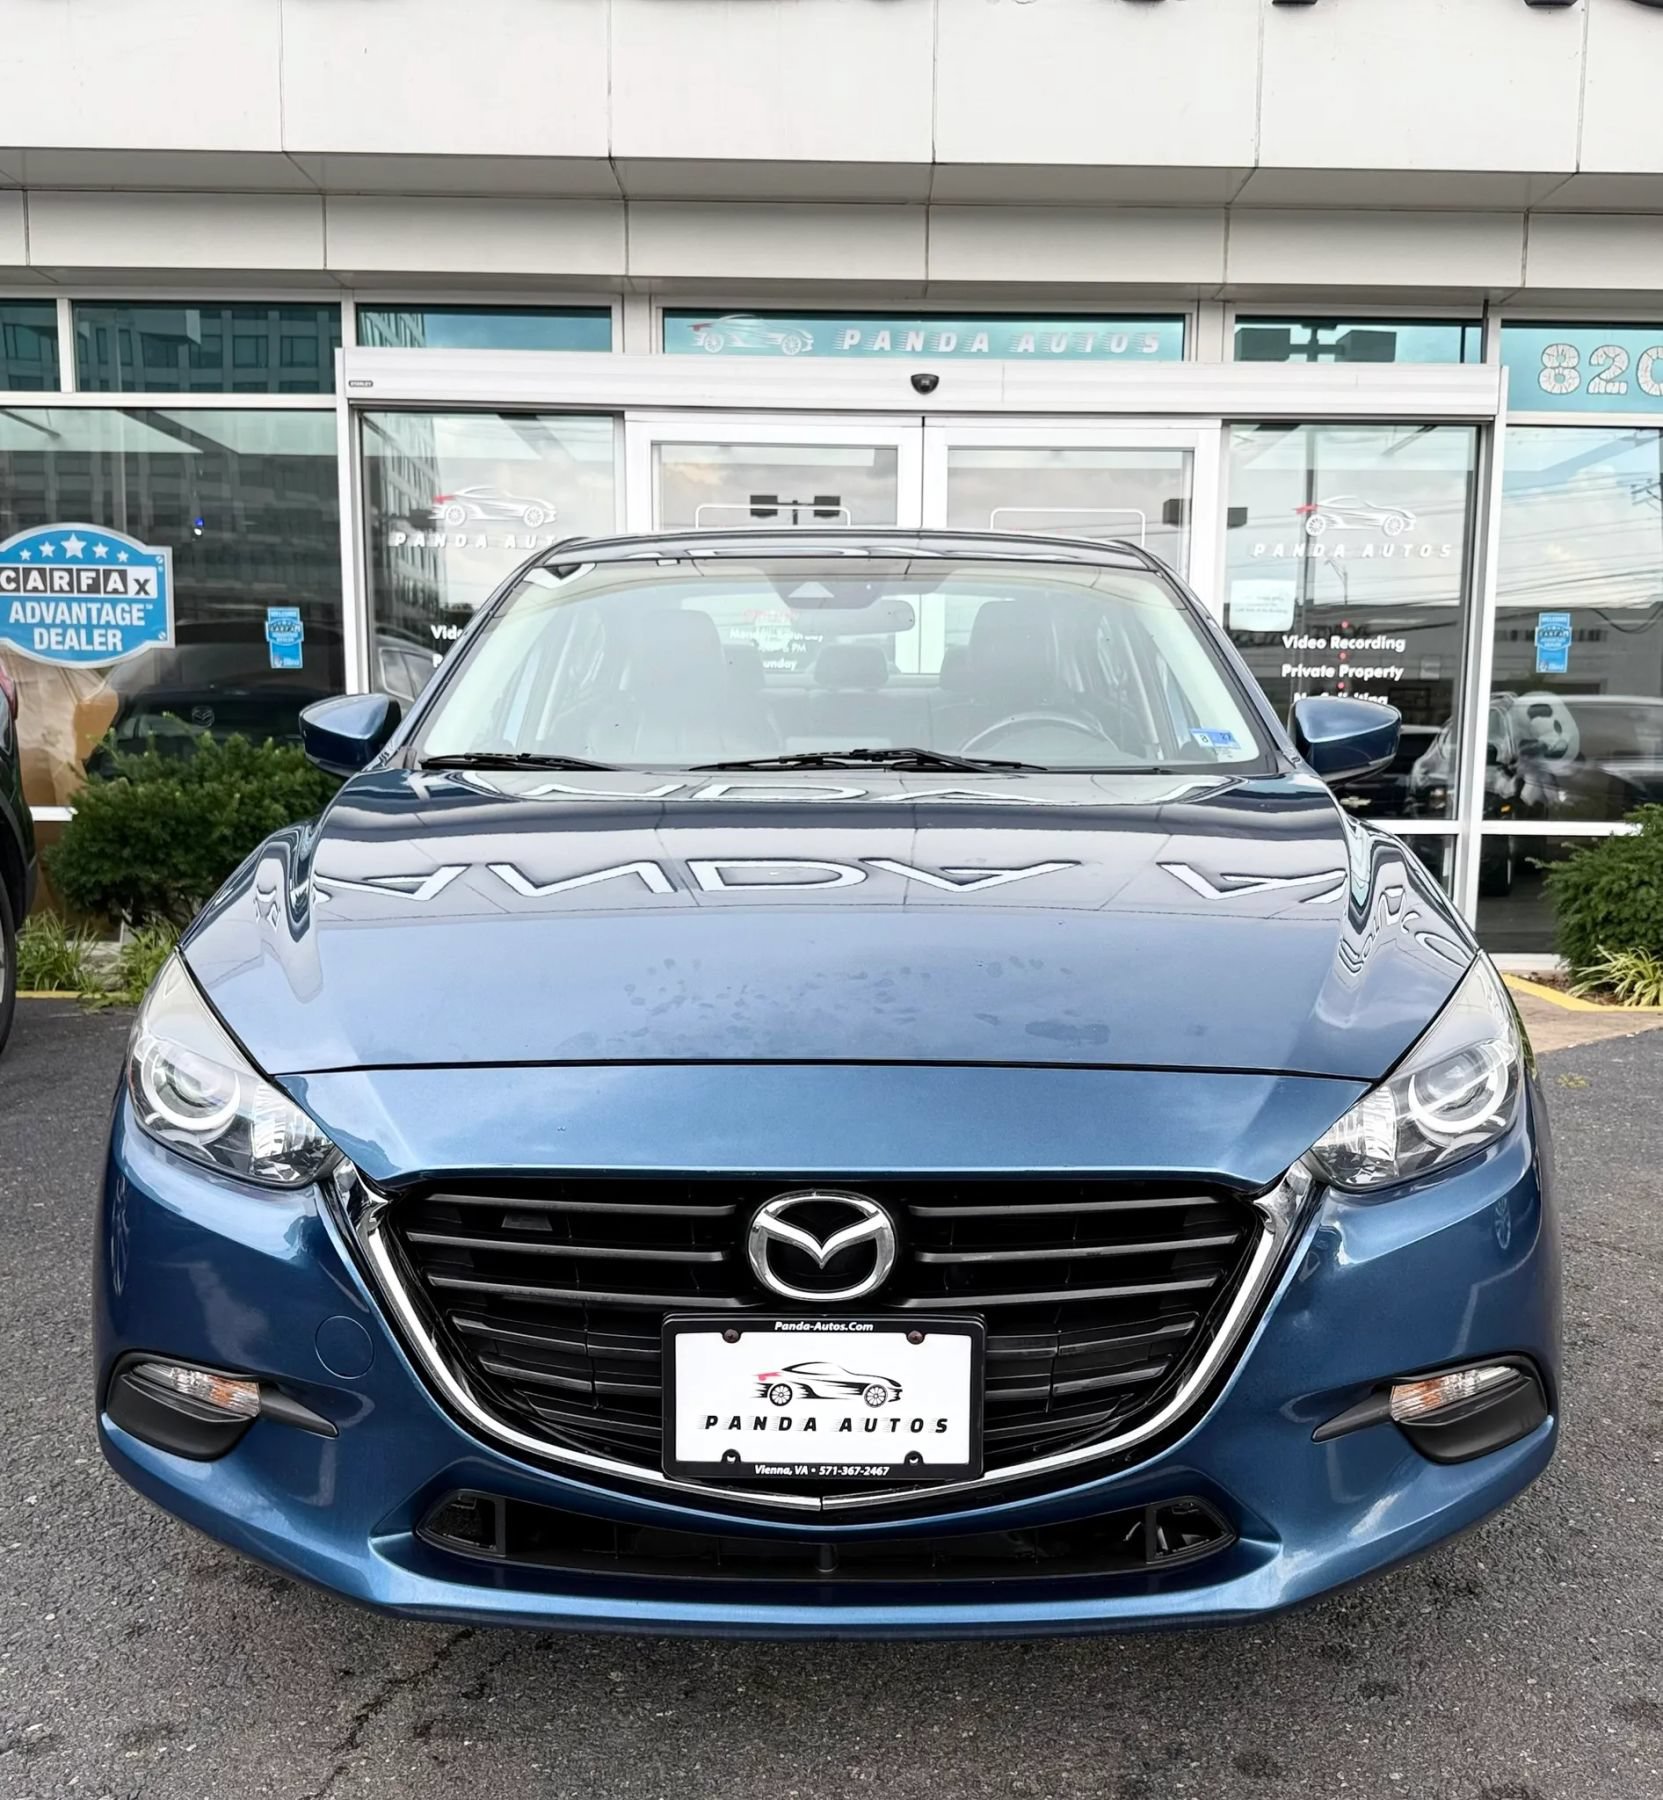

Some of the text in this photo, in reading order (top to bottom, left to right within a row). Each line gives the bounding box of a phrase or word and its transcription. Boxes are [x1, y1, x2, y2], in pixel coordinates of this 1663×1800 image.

[840, 329, 1161, 354] PANDA AUTOS
[392, 531, 489, 549] PANDA
[1252, 543, 1452, 558] PANDA AUTOS
[9, 601, 146, 626] ADVANTAGE
[33, 627, 123, 651] DEALER
[1282, 634, 1406, 652] Video Recording
[1281, 663, 1405, 681] Private Property
[774, 1321, 874, 1332] Panda-Autos.Com
[704, 1415, 948, 1433] PANDA AUTOS
[754, 1464, 890, 1477] Vienna, VA 571-367-2467
